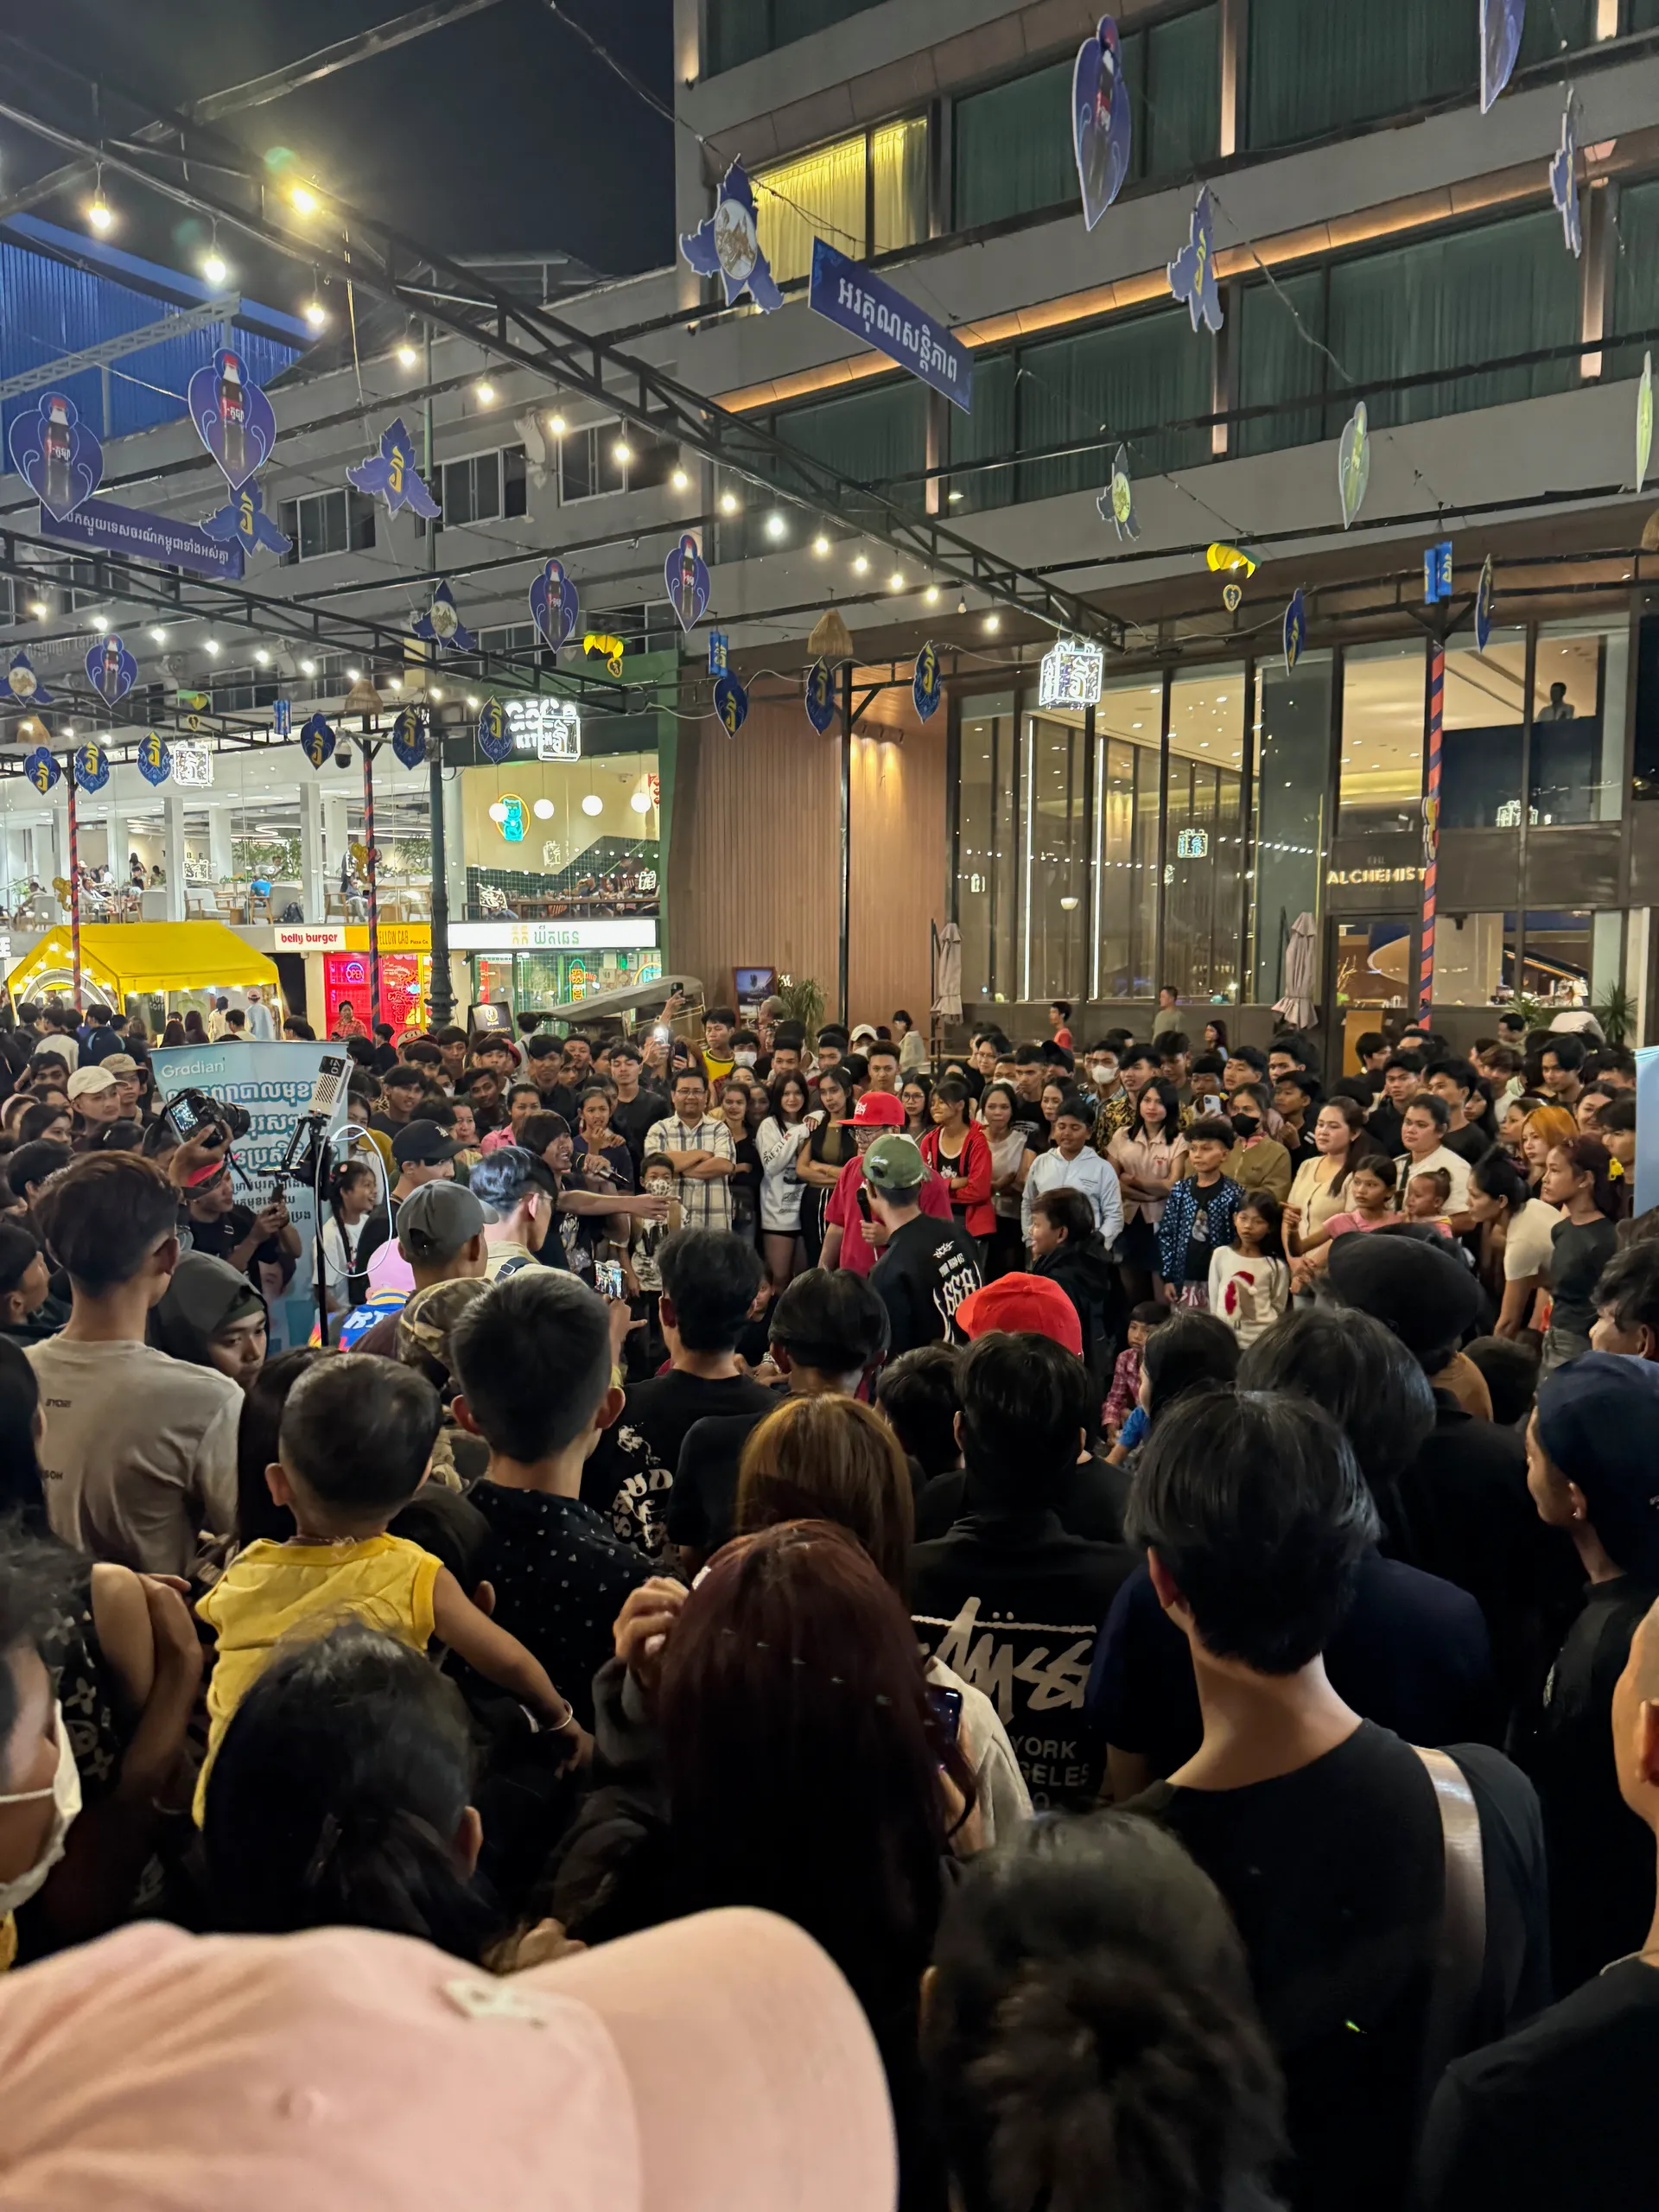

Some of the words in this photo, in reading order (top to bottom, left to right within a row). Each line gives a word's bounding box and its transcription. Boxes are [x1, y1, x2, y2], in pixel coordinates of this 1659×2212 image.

[1326, 867, 1427, 885] ALCHEMIST
[281, 933, 303, 944] belly
[305, 933, 338, 944] burger
[397, 931, 409, 944] CAB
[346, 969, 364, 980] OPEN
[1010, 1735, 1077, 1759] YORK
[1018, 1761, 1090, 1788] GELES
